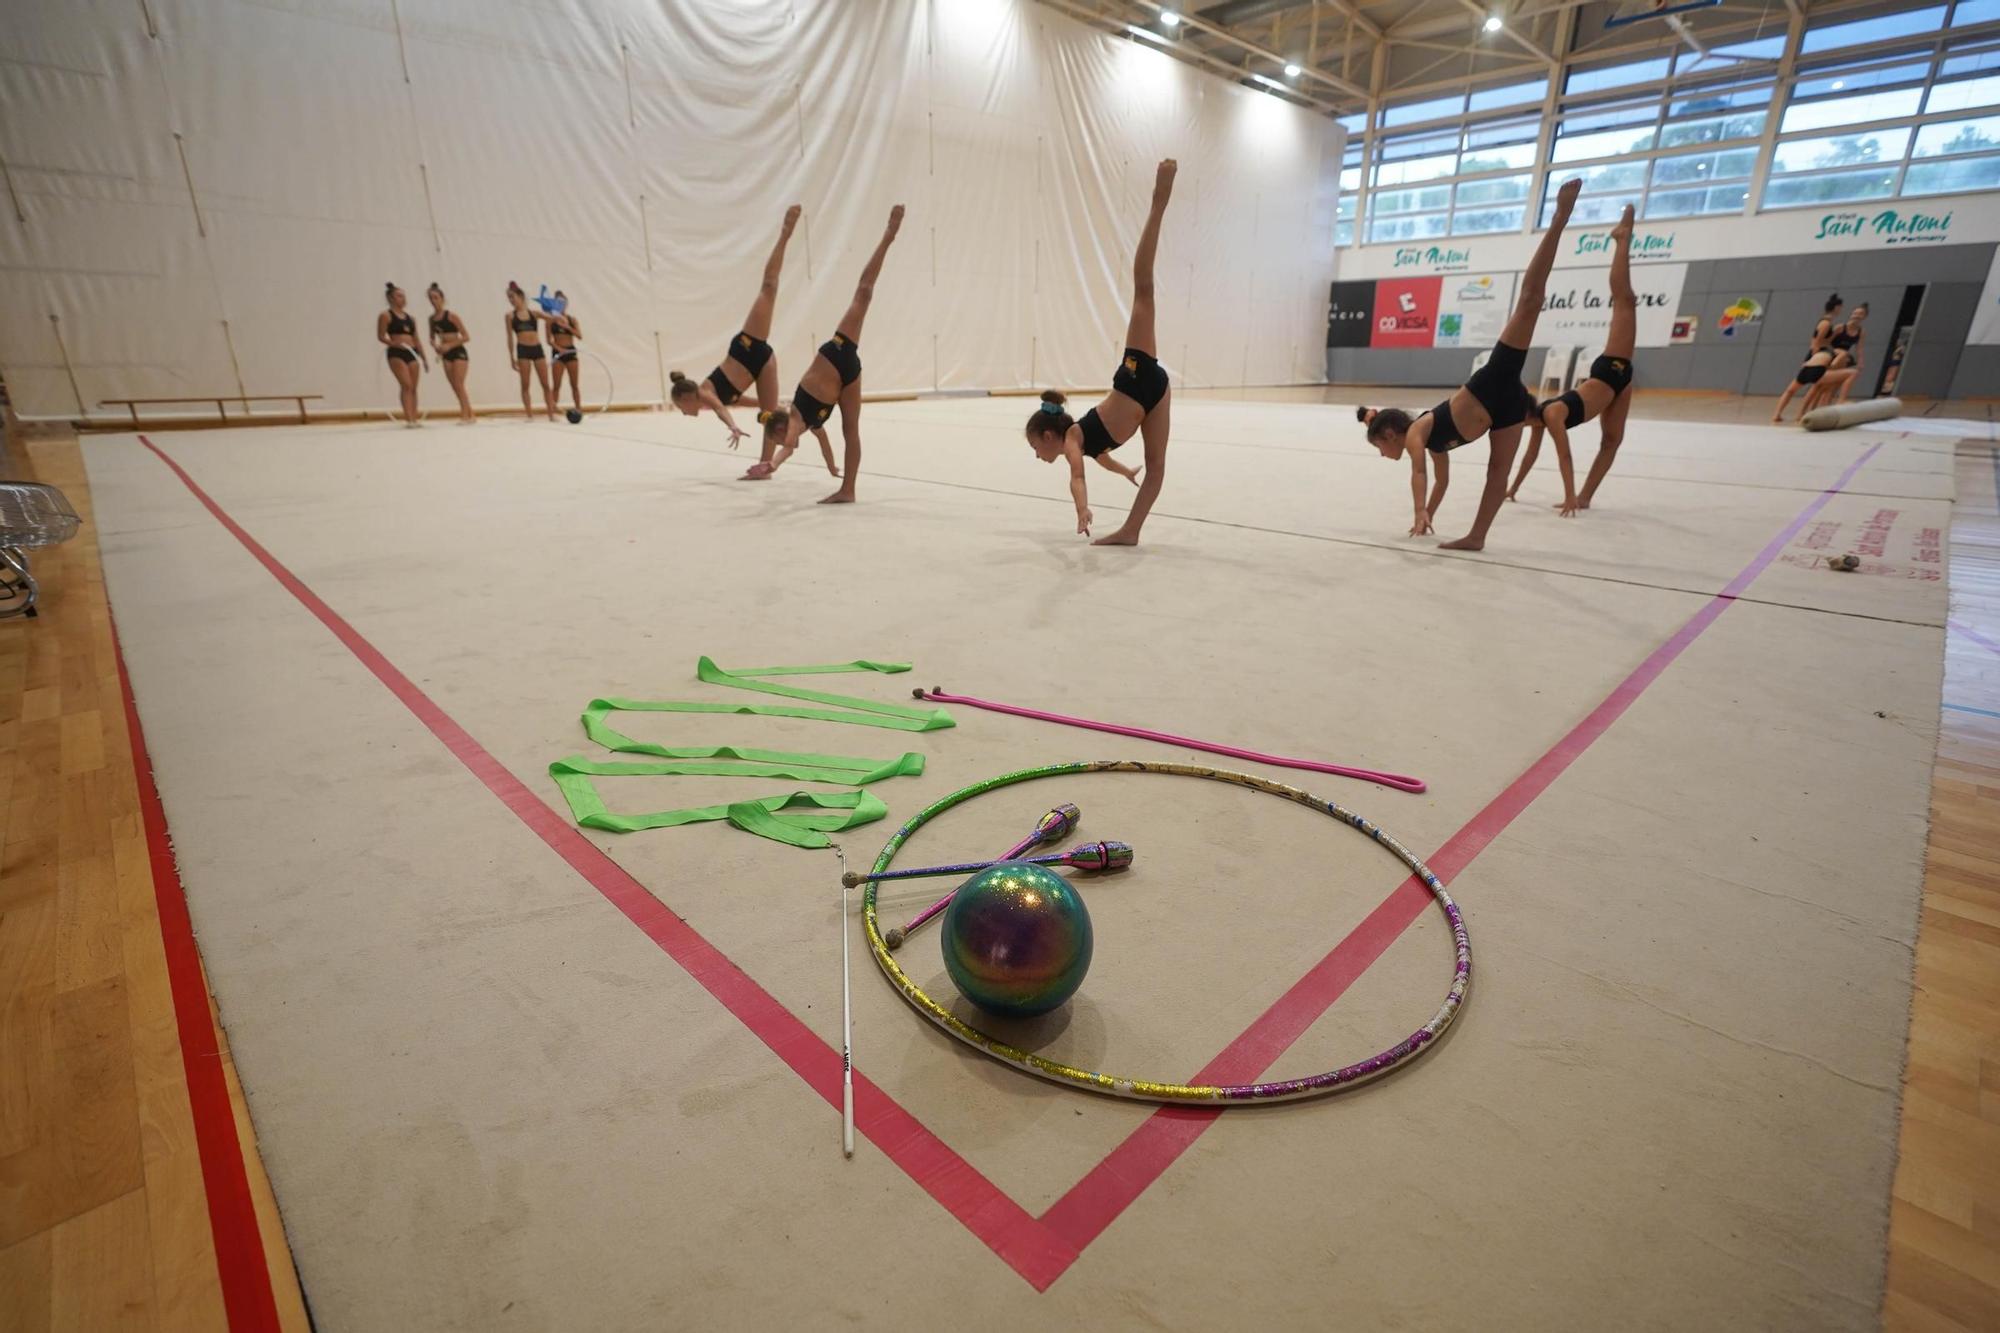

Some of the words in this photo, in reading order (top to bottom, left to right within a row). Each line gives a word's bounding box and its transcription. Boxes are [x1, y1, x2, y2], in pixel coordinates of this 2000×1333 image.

[1814, 214, 1866, 239] Sant
[1871, 209, 1953, 235] Antoni
[1574, 233, 1612, 254] Sant
[1630, 231, 1675, 251] ntoni
[1393, 248, 1421, 268] Sant
[1425, 246, 1471, 264] Antoni
[1584, 289, 1603, 308] la
[1379, 316, 1429, 331] COVICSA
